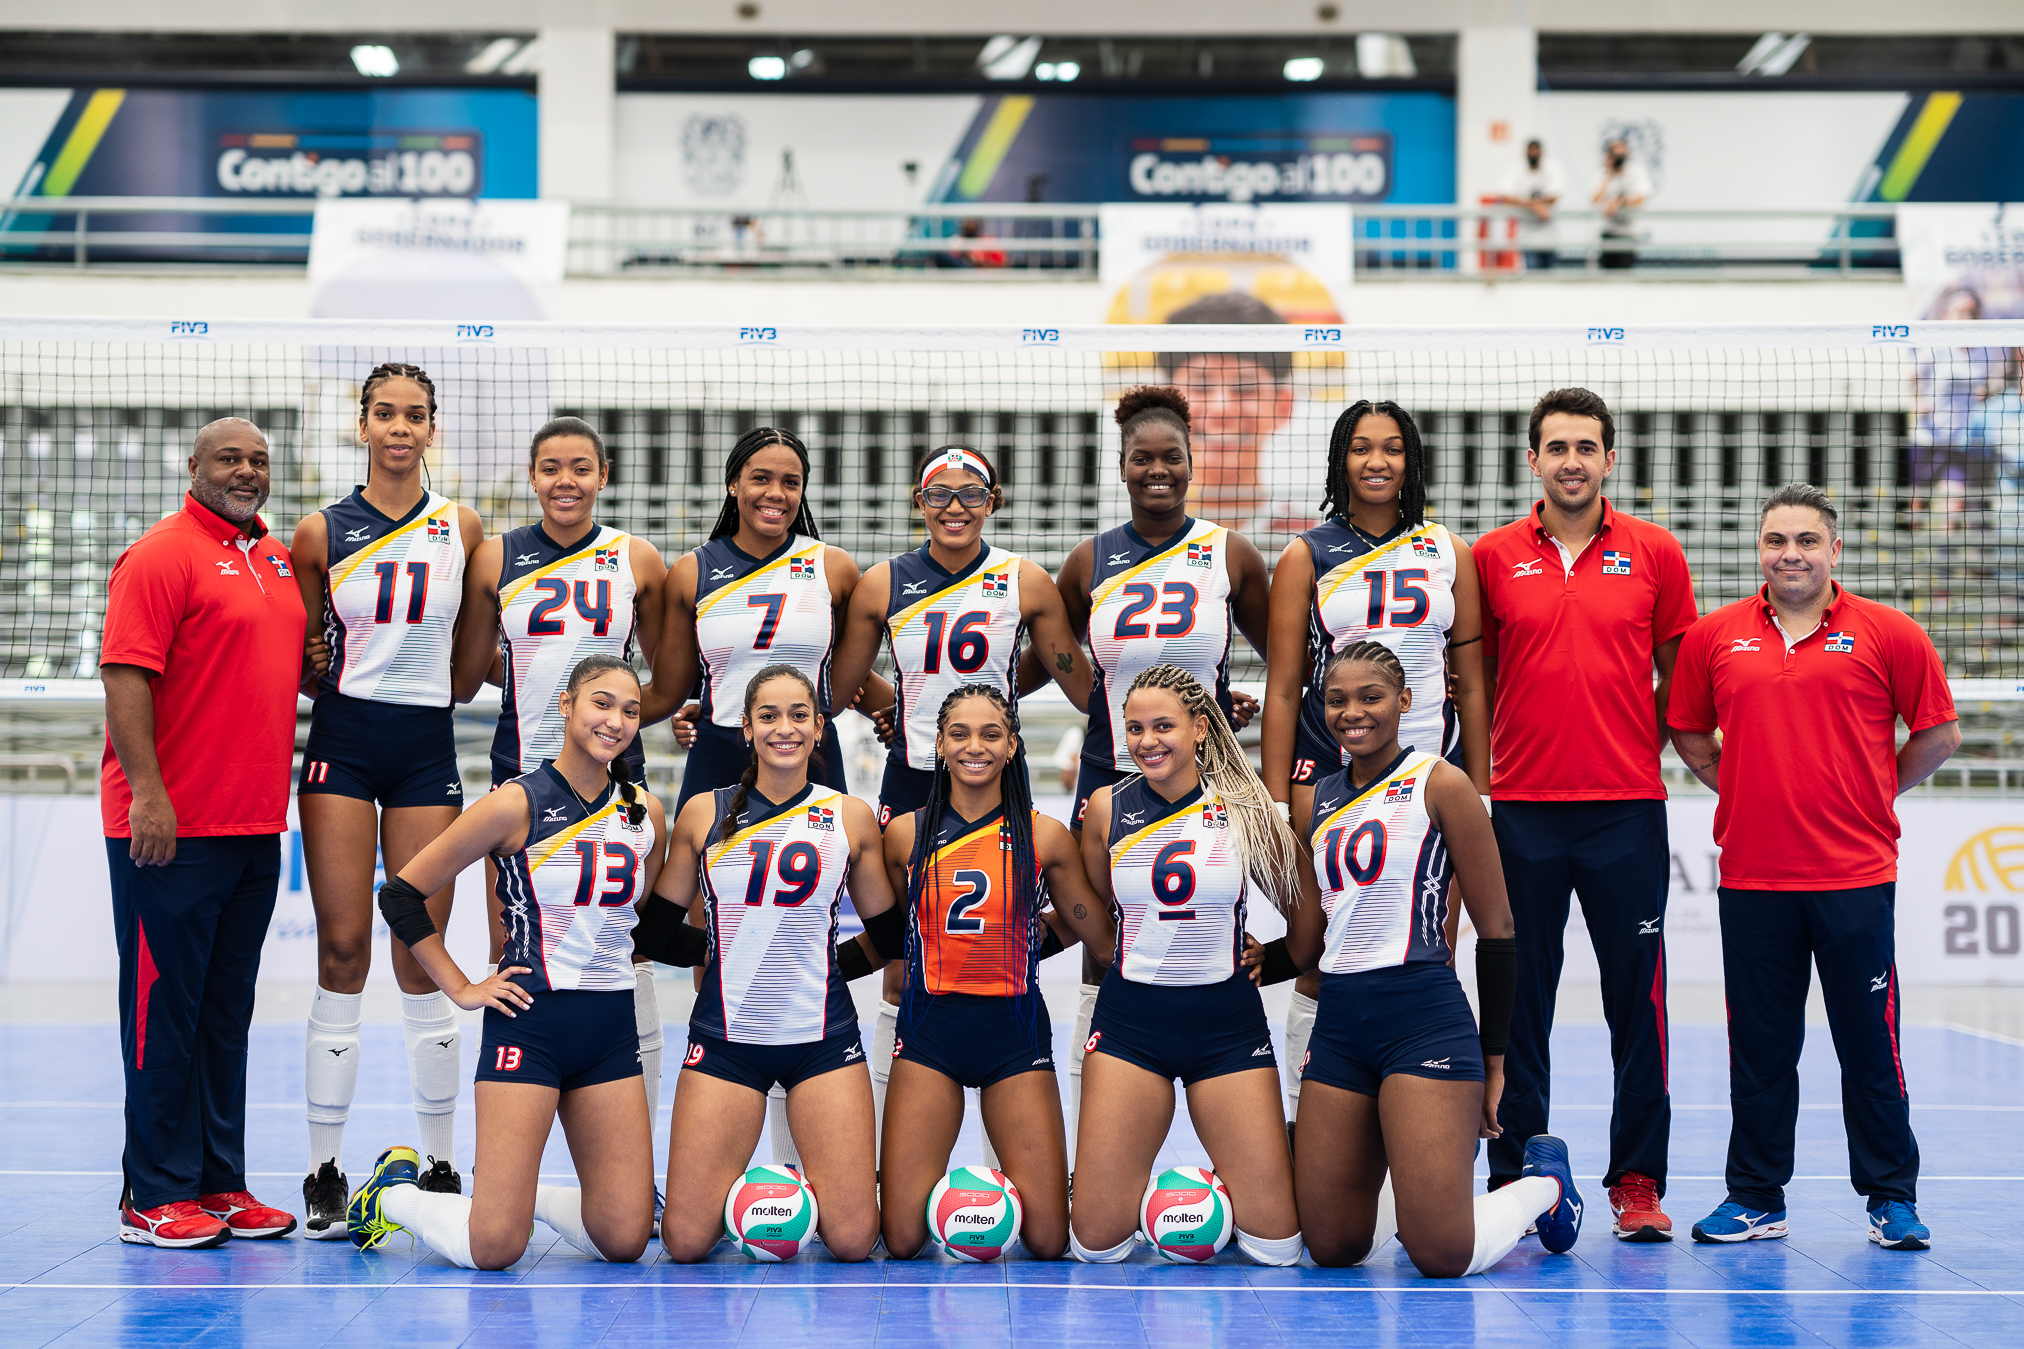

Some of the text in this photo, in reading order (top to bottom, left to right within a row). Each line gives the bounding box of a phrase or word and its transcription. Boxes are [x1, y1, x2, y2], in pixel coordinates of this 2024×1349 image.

[217, 148, 367, 198] Contigo
[1130, 153, 1280, 202] Contigo
[171, 321, 208, 334] FIVB
[457, 325, 494, 337] FIVB
[740, 327, 777, 340] FIVB
[1023, 329, 1059, 341] FIVB
[1305, 329, 1341, 341] FIVB
[1588, 328, 1624, 340] FIVB
[1872, 325, 1909, 337] FIVB
[374, 561, 430, 625] 11
[1363, 568, 1430, 629] 15
[528, 578, 613, 637] 24
[1114, 581, 1199, 640] 23
[747, 593, 787, 650] 7
[923, 610, 991, 674] 16
[307, 761, 329, 783] 11
[1291, 759, 1316, 781] 15
[1325, 819, 1387, 892] 10
[574, 840, 639, 907] 13
[744, 840, 821, 907] 19
[1151, 840, 1196, 906] 6
[945, 869, 992, 935] 2
[1944, 905, 2020, 954] 20
[1083, 1030, 1102, 1052] 6
[495, 1046, 522, 1070] 13
[683, 1042, 705, 1066] 19
[751, 1206, 792, 1217] molten
[954, 1214, 995, 1225] molten
[1163, 1213, 1203, 1223] molten
